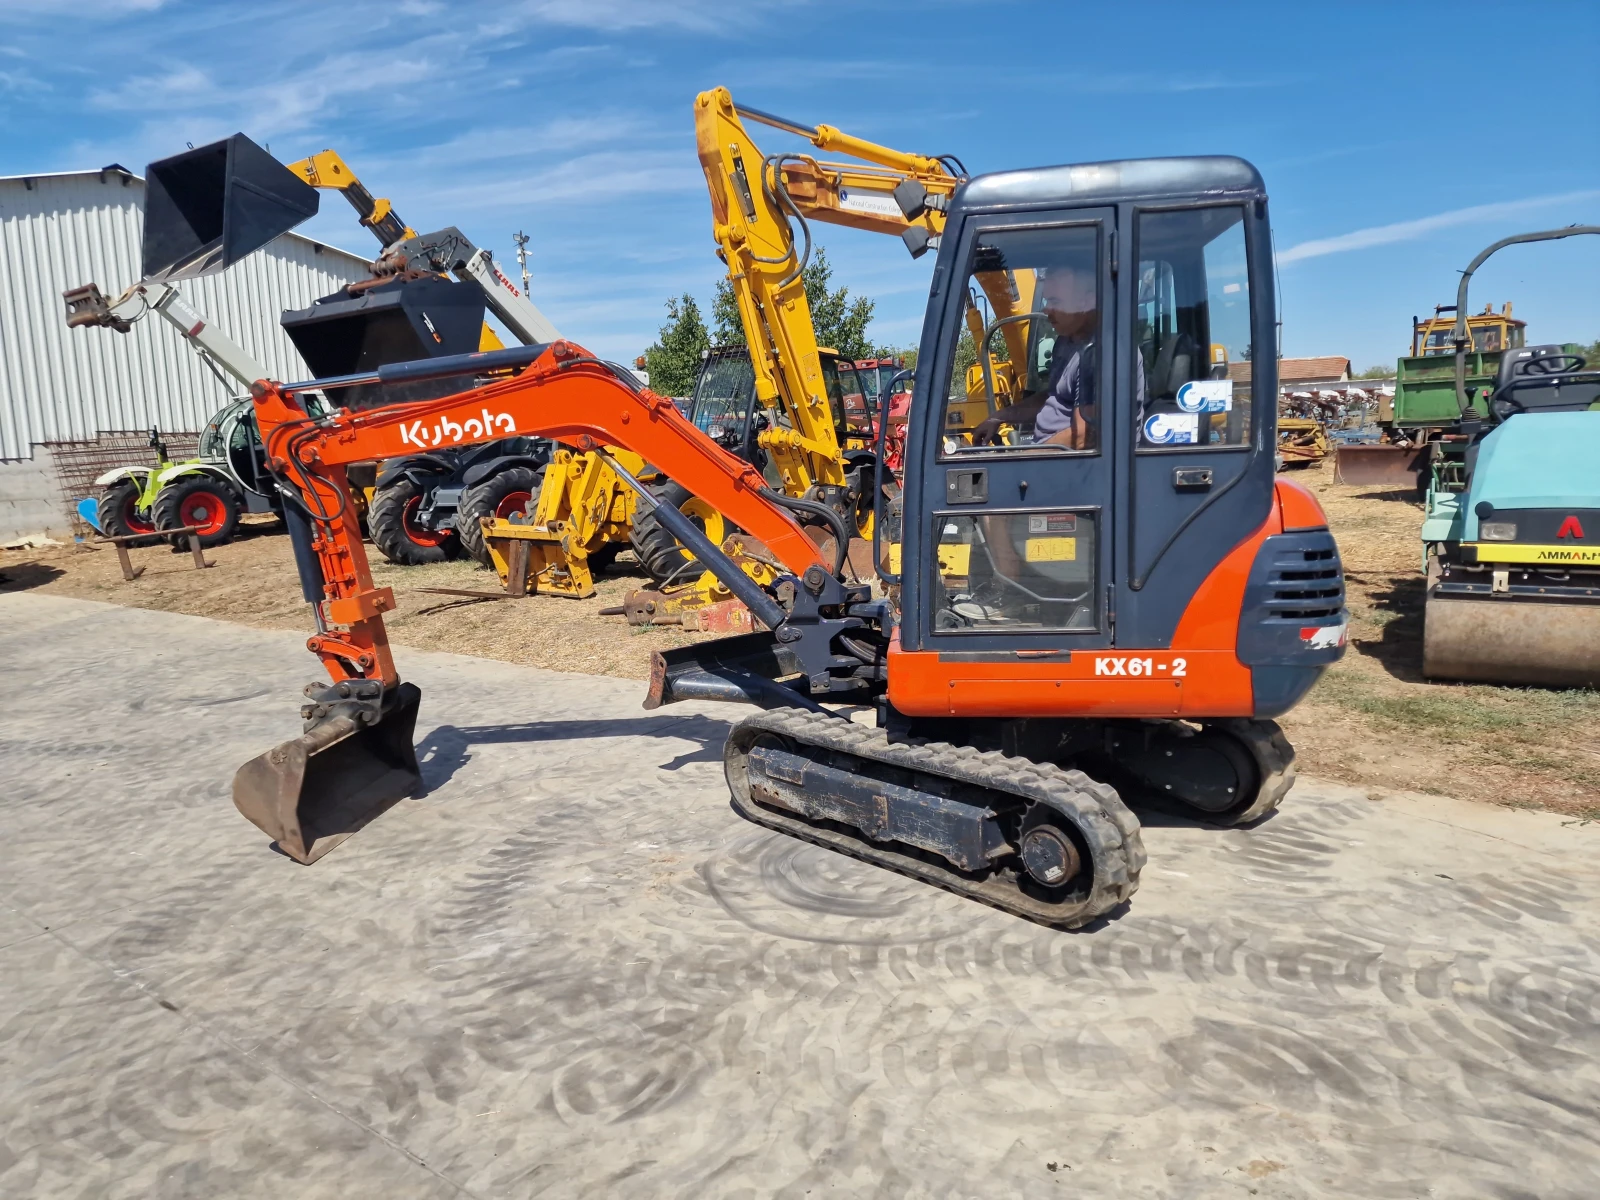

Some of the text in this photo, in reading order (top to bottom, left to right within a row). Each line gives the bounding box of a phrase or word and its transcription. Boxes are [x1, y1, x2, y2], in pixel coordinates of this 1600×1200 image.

[848, 199, 865, 207] National
[493, 269, 520, 298] CLAAS
[173, 298, 200, 320] LAAS
[400, 408, 516, 447] Kubota
[1095, 657, 1153, 676] KX61
[1171, 657, 1187, 677] 2
